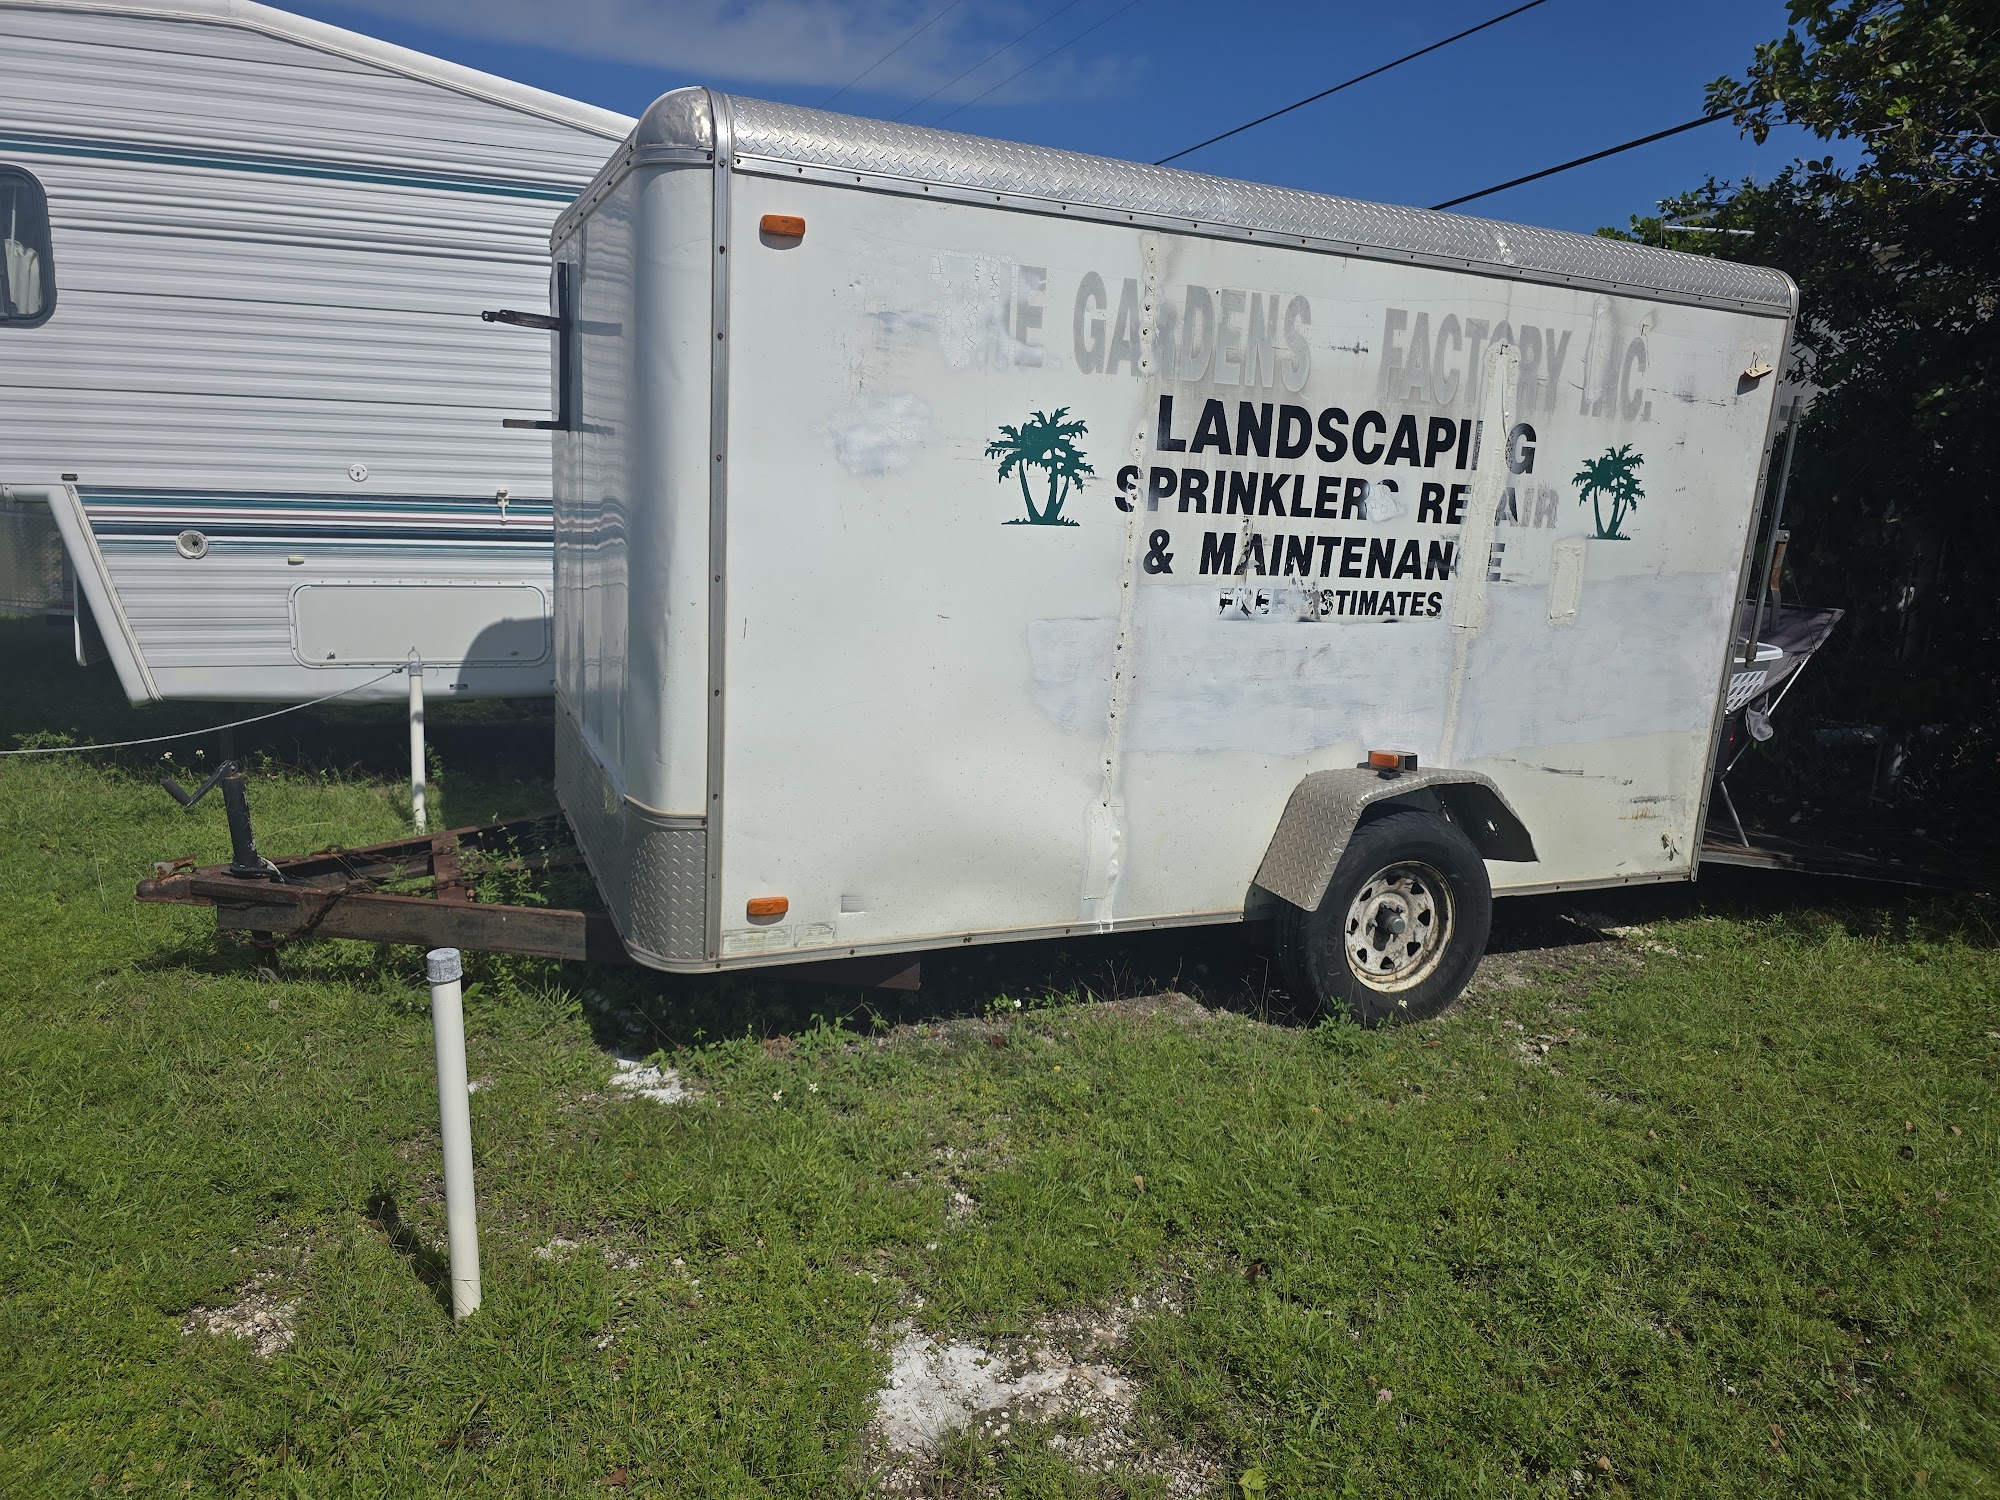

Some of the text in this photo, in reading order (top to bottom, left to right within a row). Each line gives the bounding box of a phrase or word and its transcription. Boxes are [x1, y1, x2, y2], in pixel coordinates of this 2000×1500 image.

[1417, 482, 1559, 530] REAIR
[1143, 529, 1506, 582] & MAINTENANE
[1303, 589, 1443, 619] STIMATES
